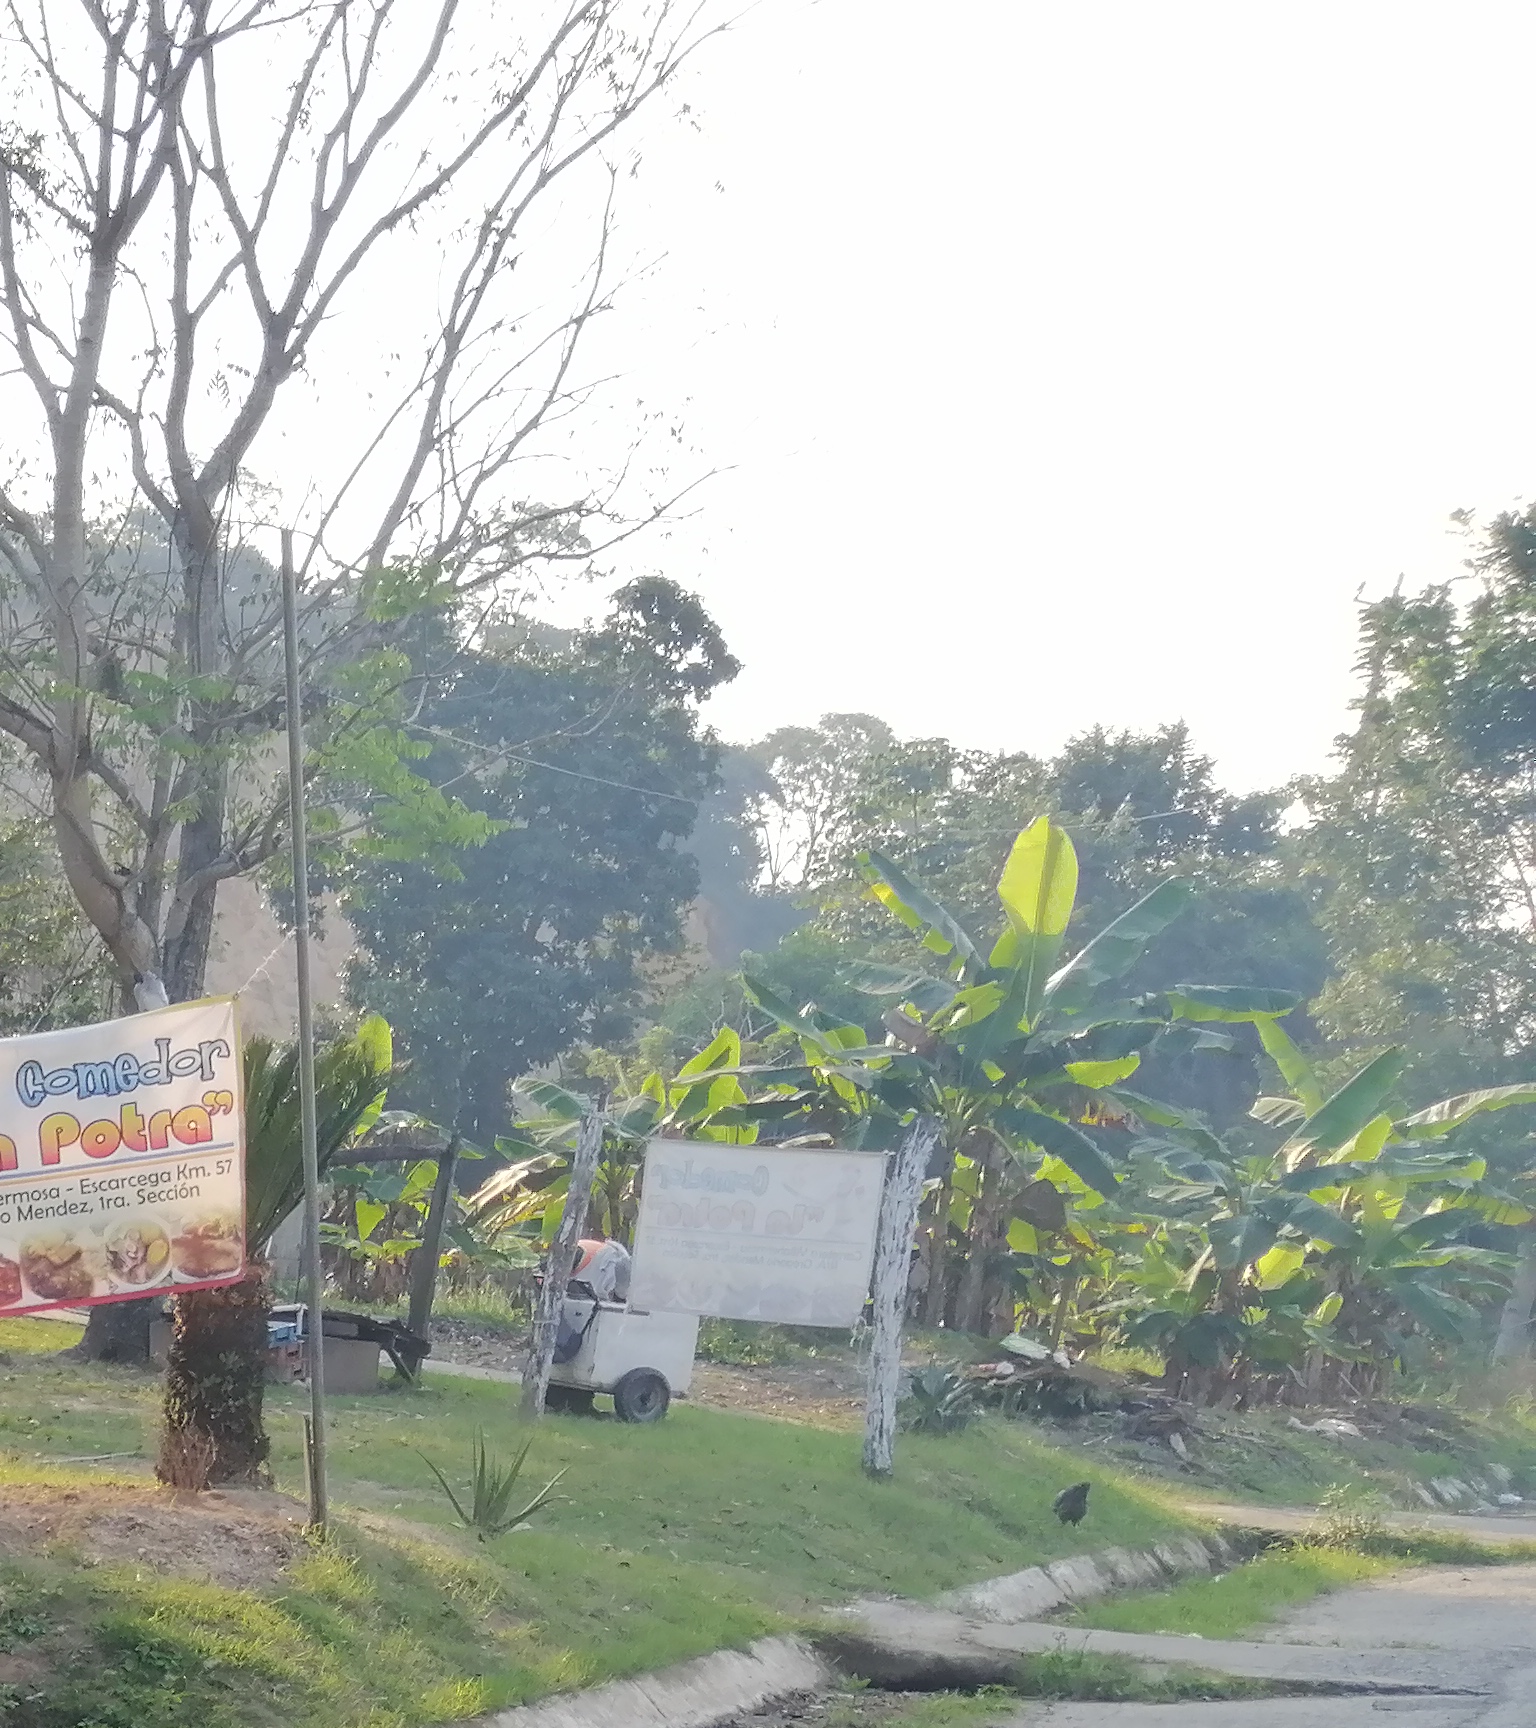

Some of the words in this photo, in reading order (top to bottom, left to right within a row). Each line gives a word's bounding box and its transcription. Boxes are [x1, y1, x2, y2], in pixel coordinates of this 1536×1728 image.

[16, 1038, 230, 1108] Comedor
[80, 1170, 171, 1195] Escarcega
[177, 1164, 210, 1181] Km.
[216, 1159, 232, 1174] 57
[17, 1200, 94, 1222] Mendez,
[100, 1196, 130, 1210] 1ra.
[137, 1182, 200, 1206] Sección
